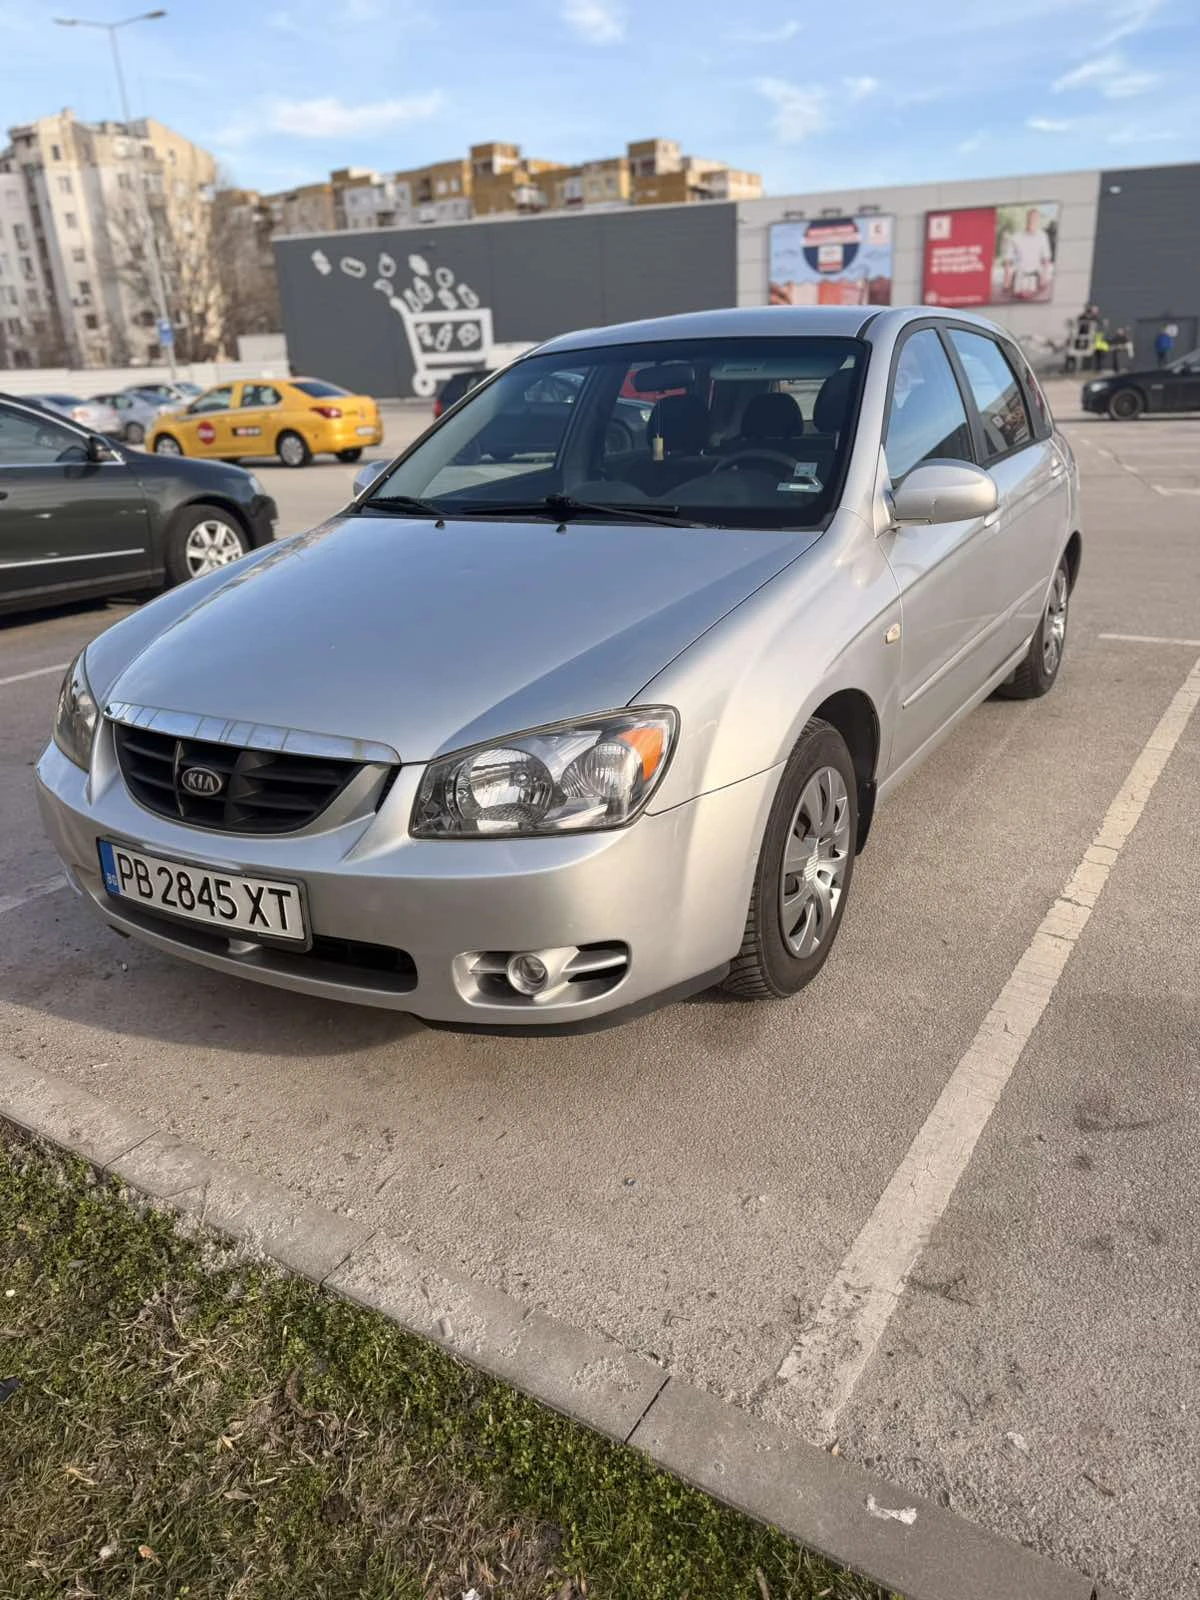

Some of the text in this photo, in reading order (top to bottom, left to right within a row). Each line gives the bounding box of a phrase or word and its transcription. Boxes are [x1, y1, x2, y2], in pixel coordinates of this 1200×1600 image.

[188, 772, 215, 792] KIA
[117, 853, 292, 930] PB 2845 XT
